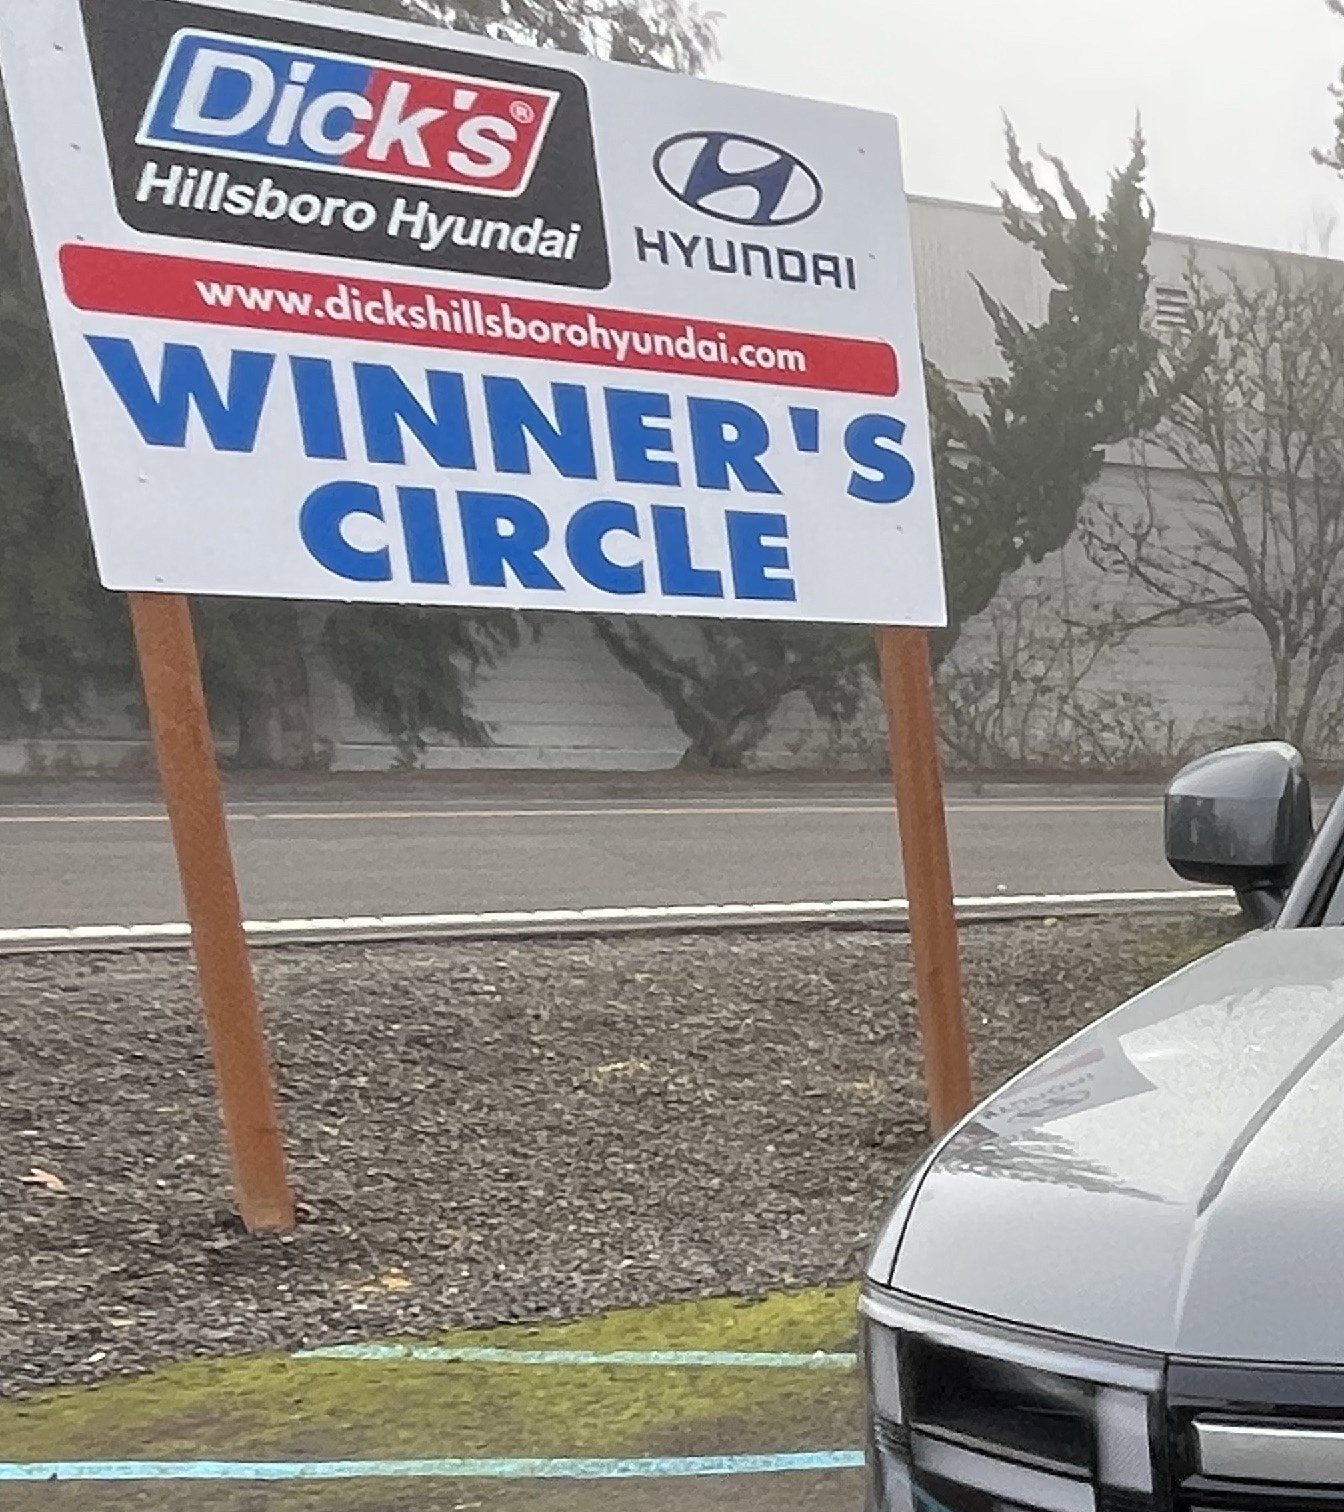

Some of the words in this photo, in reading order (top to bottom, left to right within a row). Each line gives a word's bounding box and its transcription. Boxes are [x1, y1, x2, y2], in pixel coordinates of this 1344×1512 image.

[172, 48, 518, 179] Dick's
[135, 160, 377, 231] Hillsboro
[386, 198, 582, 261] Hyundai
[635, 226, 857, 290] HYUNDAI
[195, 277, 807, 373] www.dickshillsborohyundai.com
[84, 335, 915, 504] WINNER'S
[298, 480, 796, 601] CIRCLE
